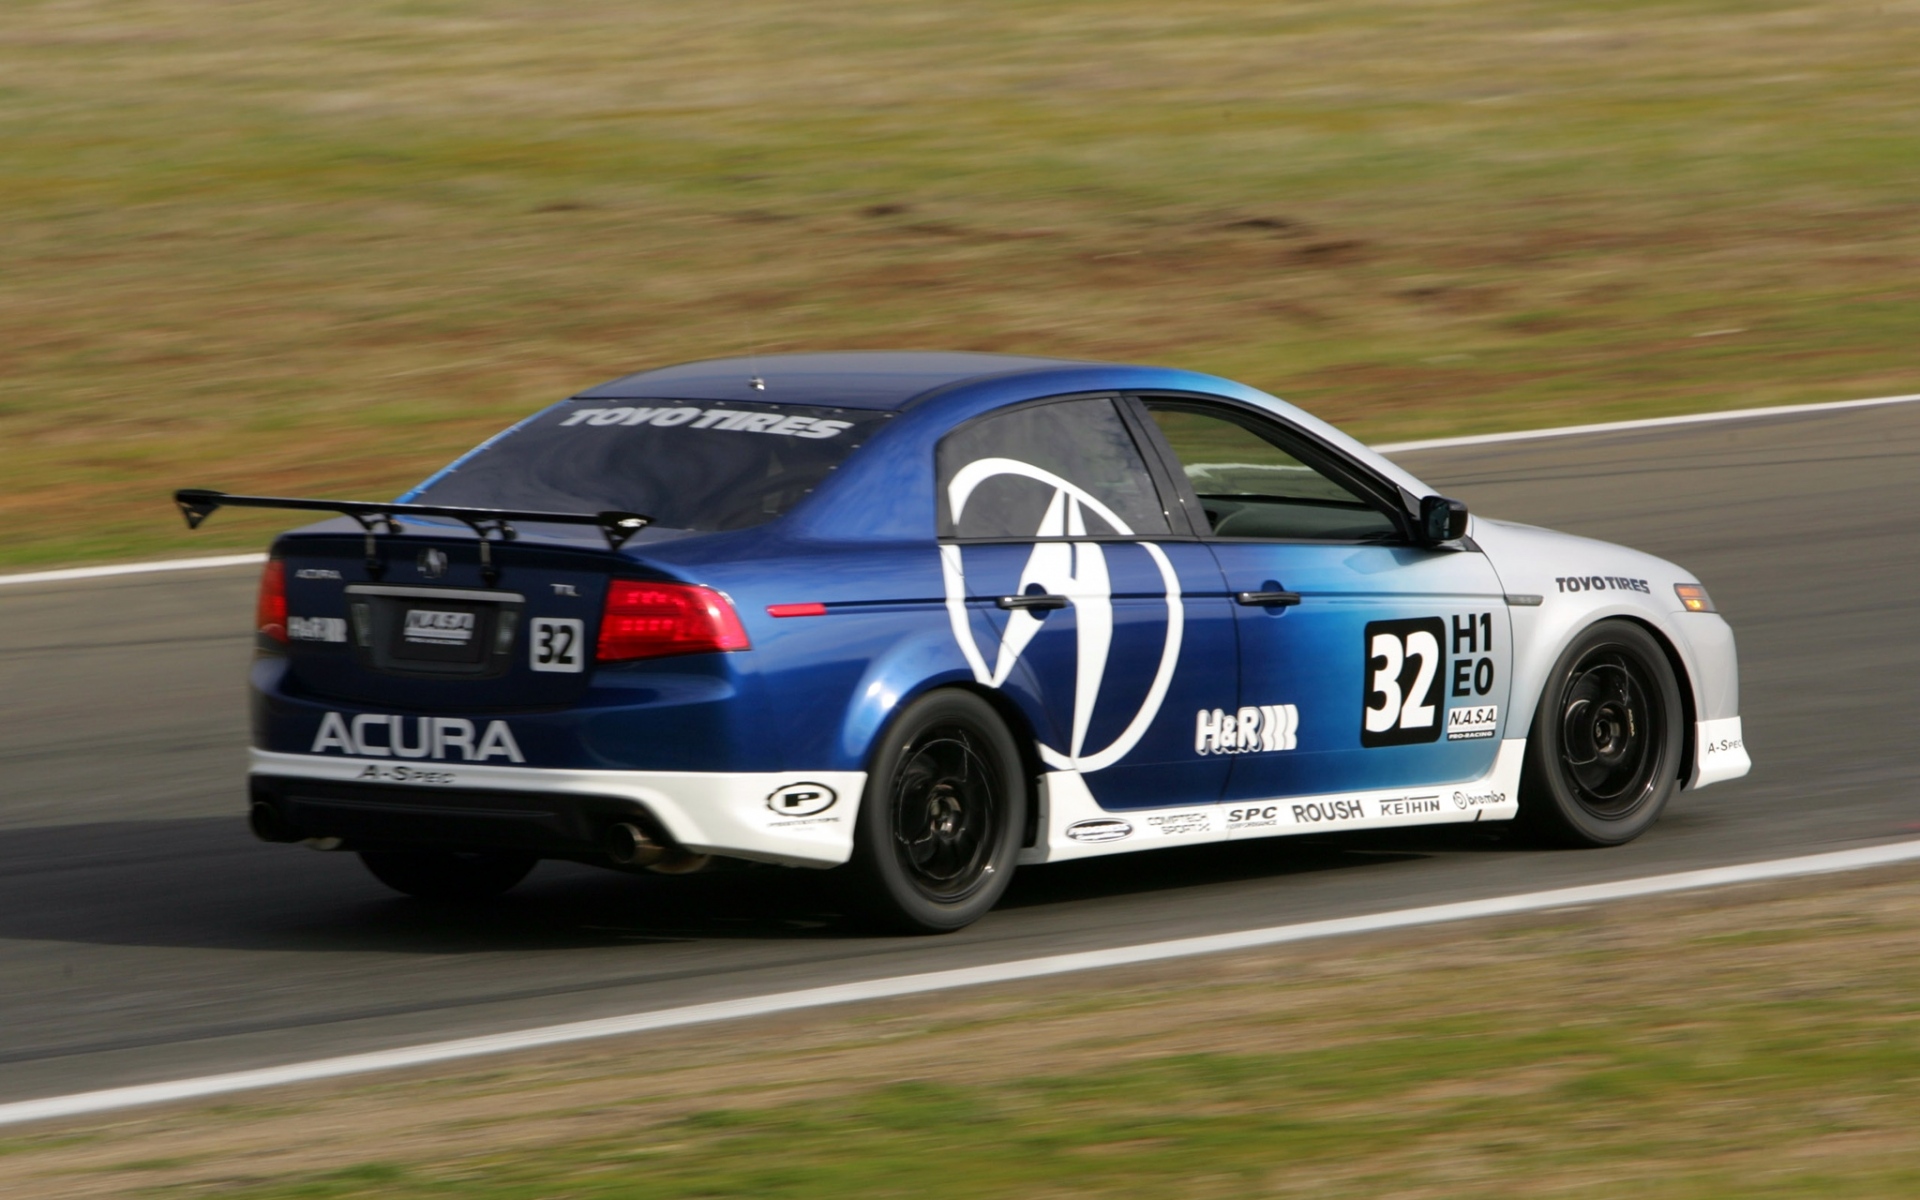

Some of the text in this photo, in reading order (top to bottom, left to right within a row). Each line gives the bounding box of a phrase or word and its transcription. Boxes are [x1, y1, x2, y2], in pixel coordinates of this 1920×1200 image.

[559, 407, 855, 439] TOYO TIRES
[1555, 576, 1651, 594] TOYO TIRES
[538, 624, 574, 664] 32
[1452, 613, 1491, 654] H1
[1366, 631, 1439, 732] 32
[311, 712, 526, 763] ACURA
[1195, 706, 1262, 755] H&R
[1292, 800, 1365, 823] ROUSH
[1381, 800, 1440, 816] KEIHIN
[1466, 790, 1506, 805] brembo
[1228, 806, 1278, 823] SPC
